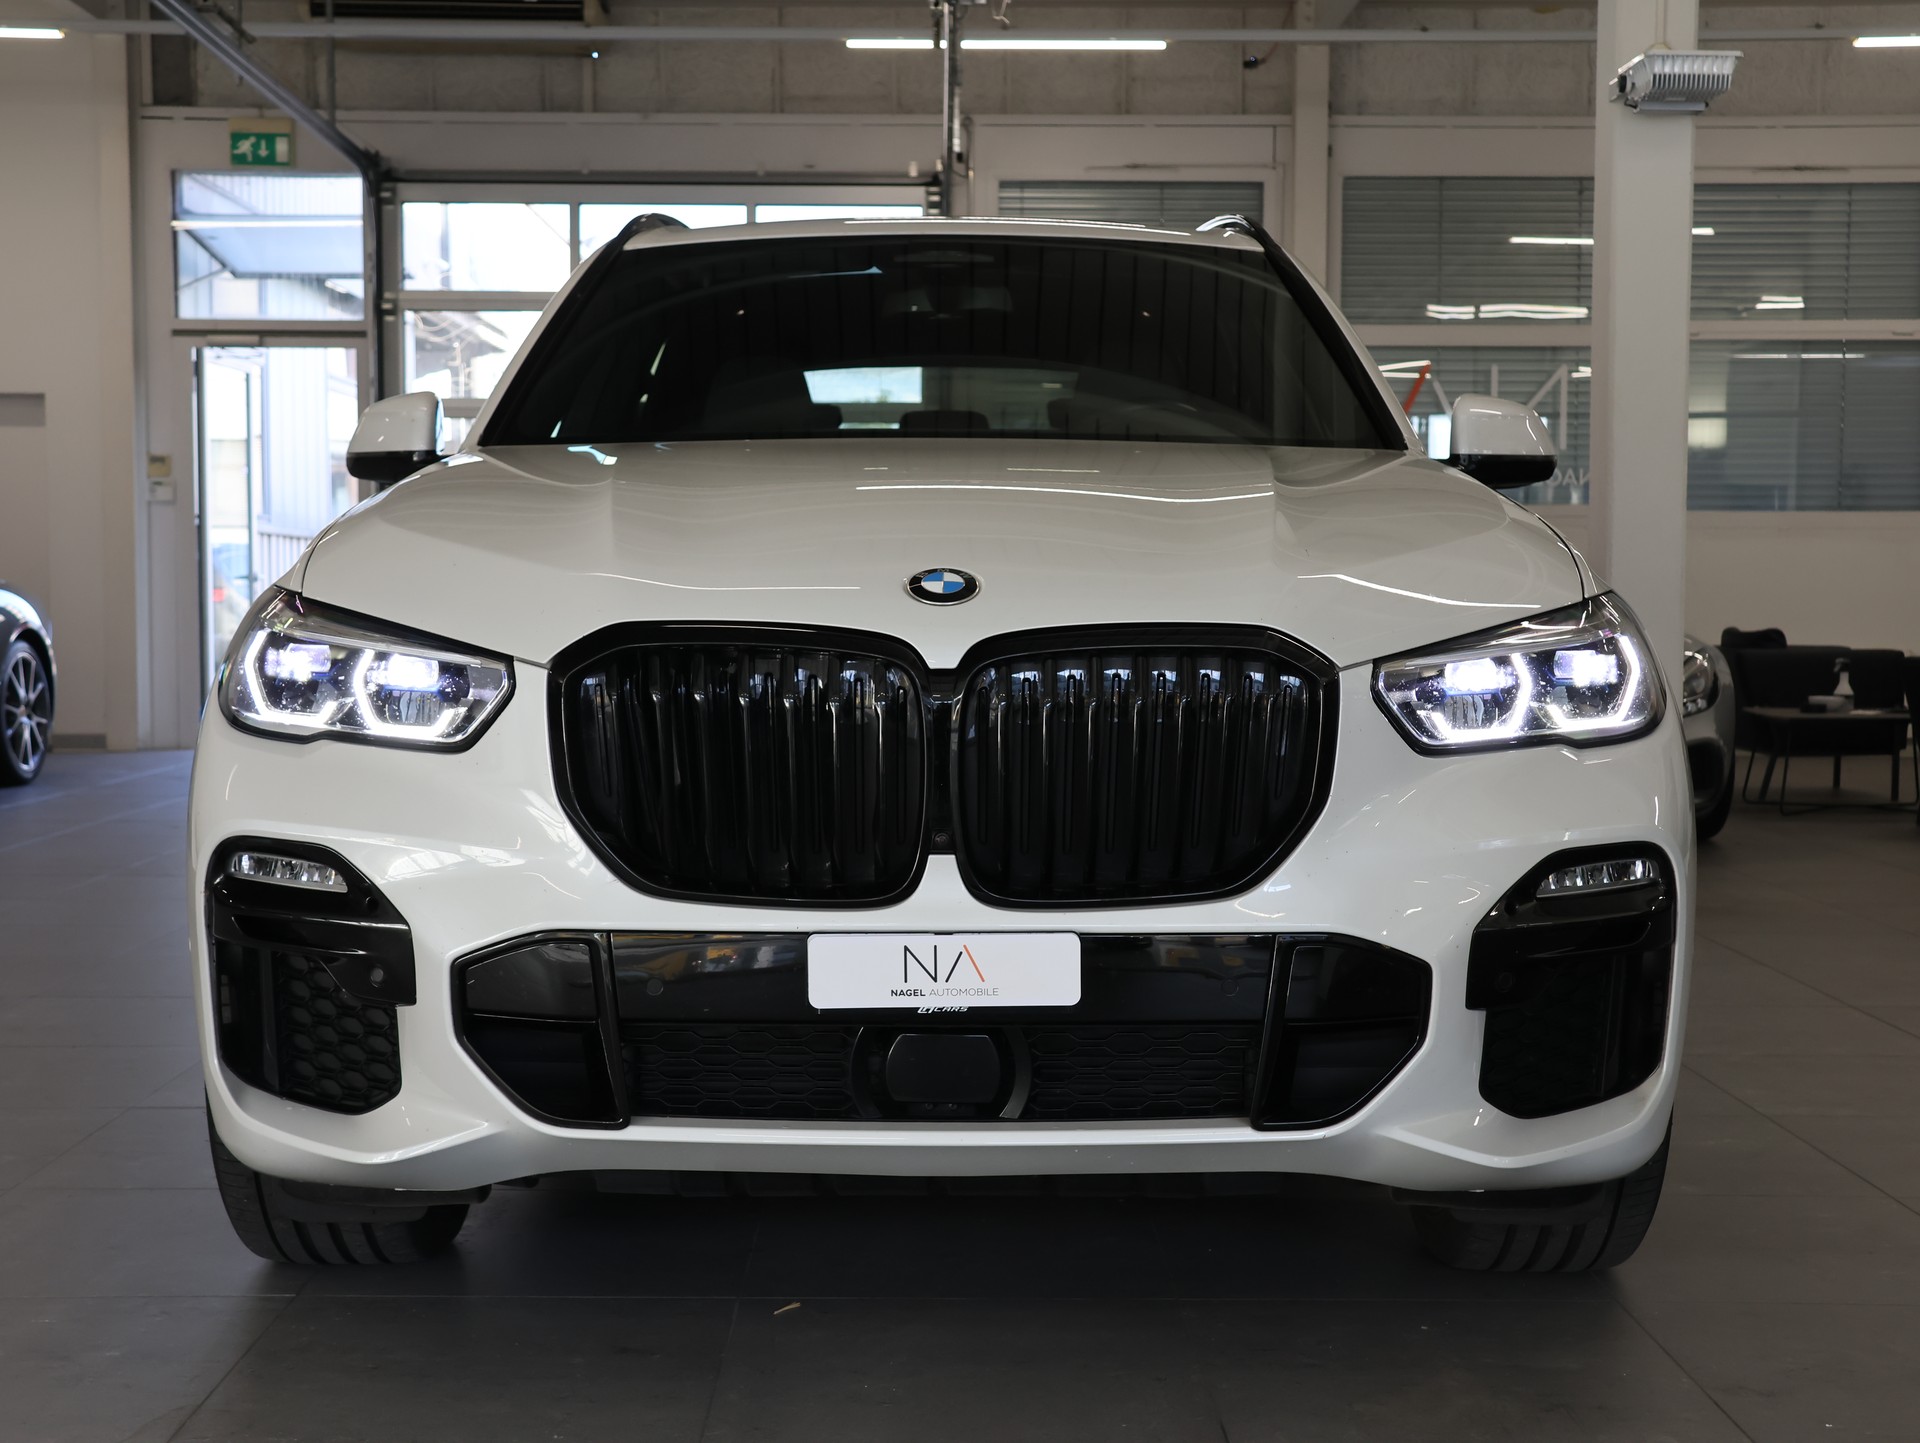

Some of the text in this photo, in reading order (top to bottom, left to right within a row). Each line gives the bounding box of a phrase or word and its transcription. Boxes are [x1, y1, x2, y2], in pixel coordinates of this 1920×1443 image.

[904, 944, 985, 983] NA
[890, 988, 999, 997] NAGEL AUTOMOBILE
